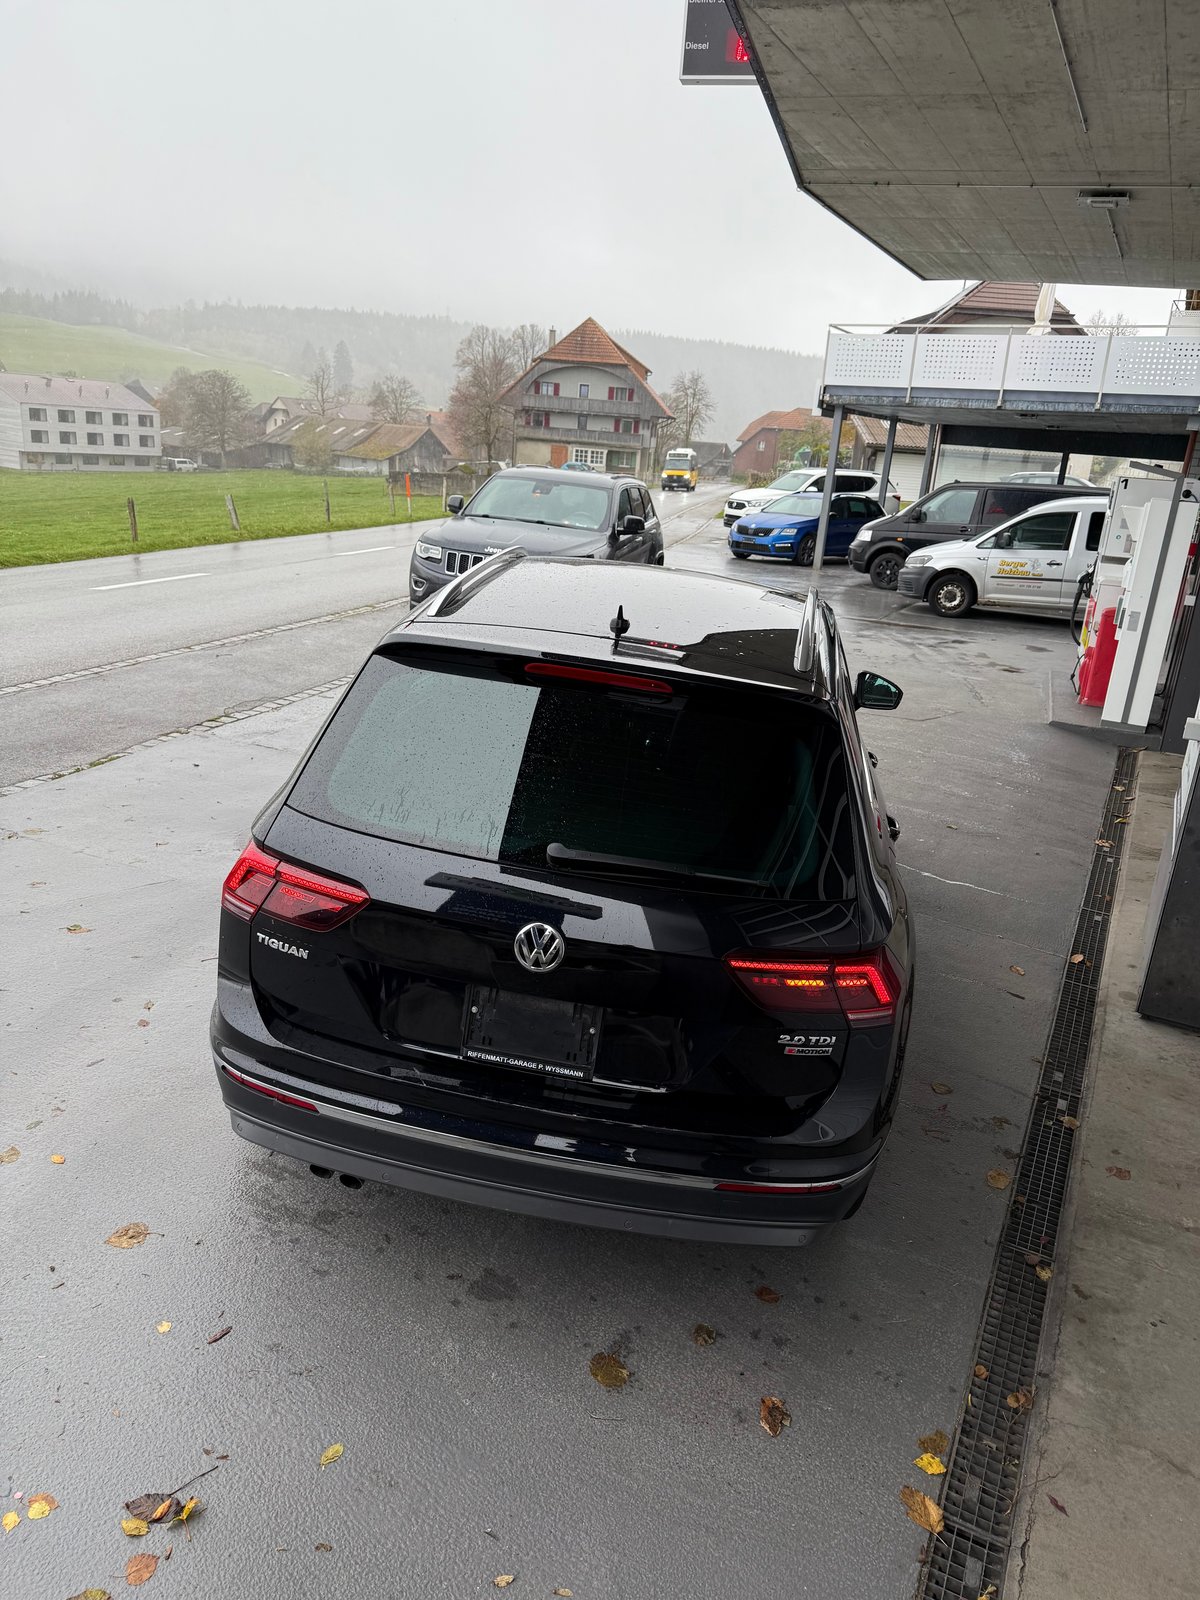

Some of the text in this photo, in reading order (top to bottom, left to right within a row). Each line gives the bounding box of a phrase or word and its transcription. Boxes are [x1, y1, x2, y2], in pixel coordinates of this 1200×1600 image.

[685, 41, 709, 50] Diesel
[1121, 479, 1129, 490] 1
[999, 560, 1028, 569] Berger
[257, 932, 309, 959] TIGUAN
[777, 1034, 837, 1046] 2.0 TDI
[467, 1051, 584, 1077] RIFFENMATT-GARAGE P. WYSSMANN
